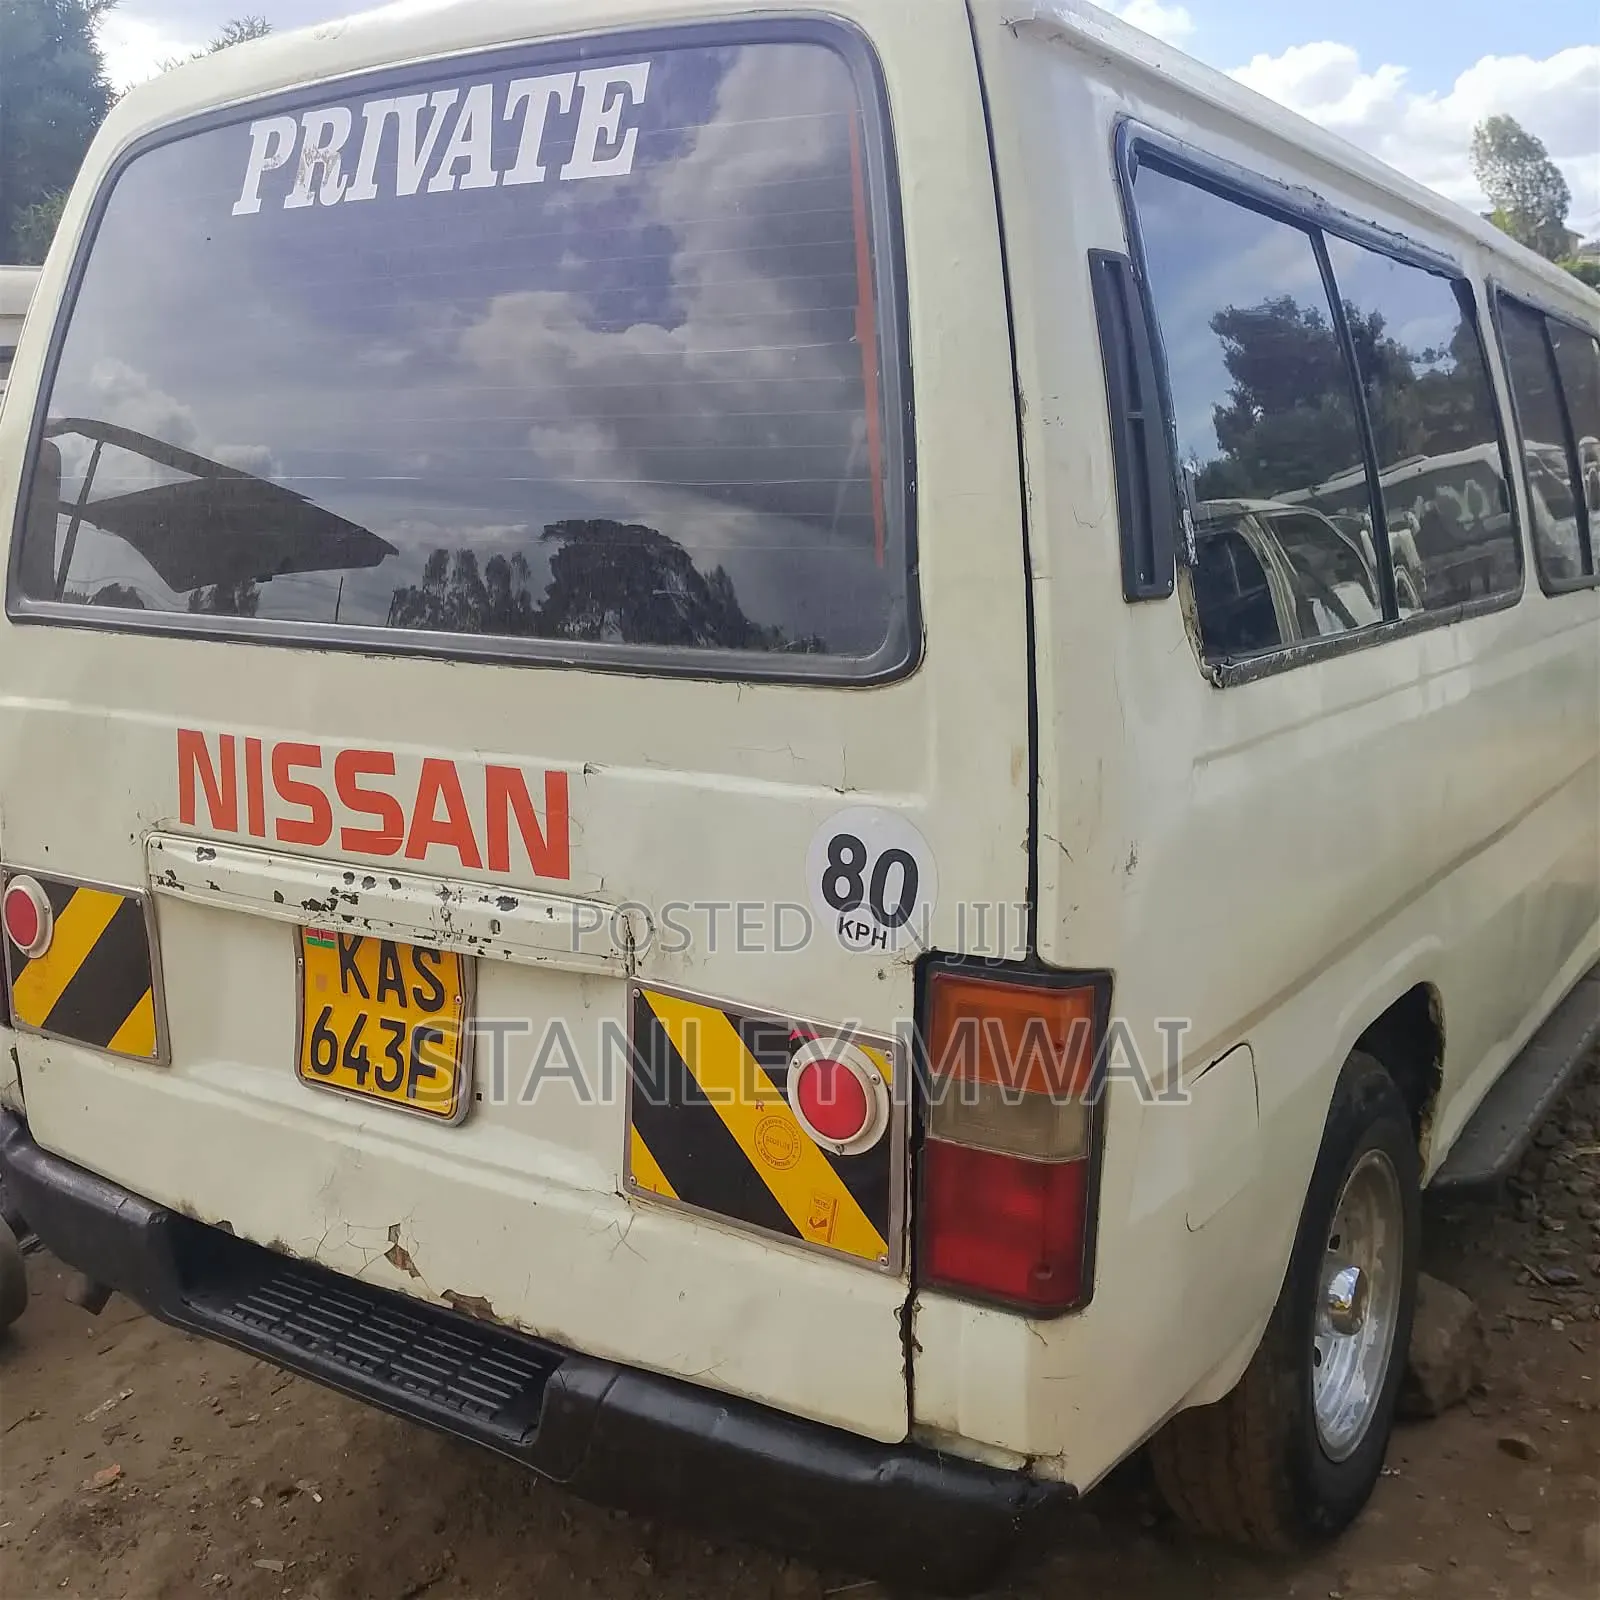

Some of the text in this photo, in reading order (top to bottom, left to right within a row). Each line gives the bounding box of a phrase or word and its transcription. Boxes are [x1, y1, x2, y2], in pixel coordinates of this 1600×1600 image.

[231, 61, 651, 216] PRIVATE
[177, 728, 571, 880] NISSAN
[821, 833, 919, 928] 80
[338, 932, 445, 1013] KAS
[838, 916, 888, 950] KPH
[310, 1005, 444, 1099] 643F
